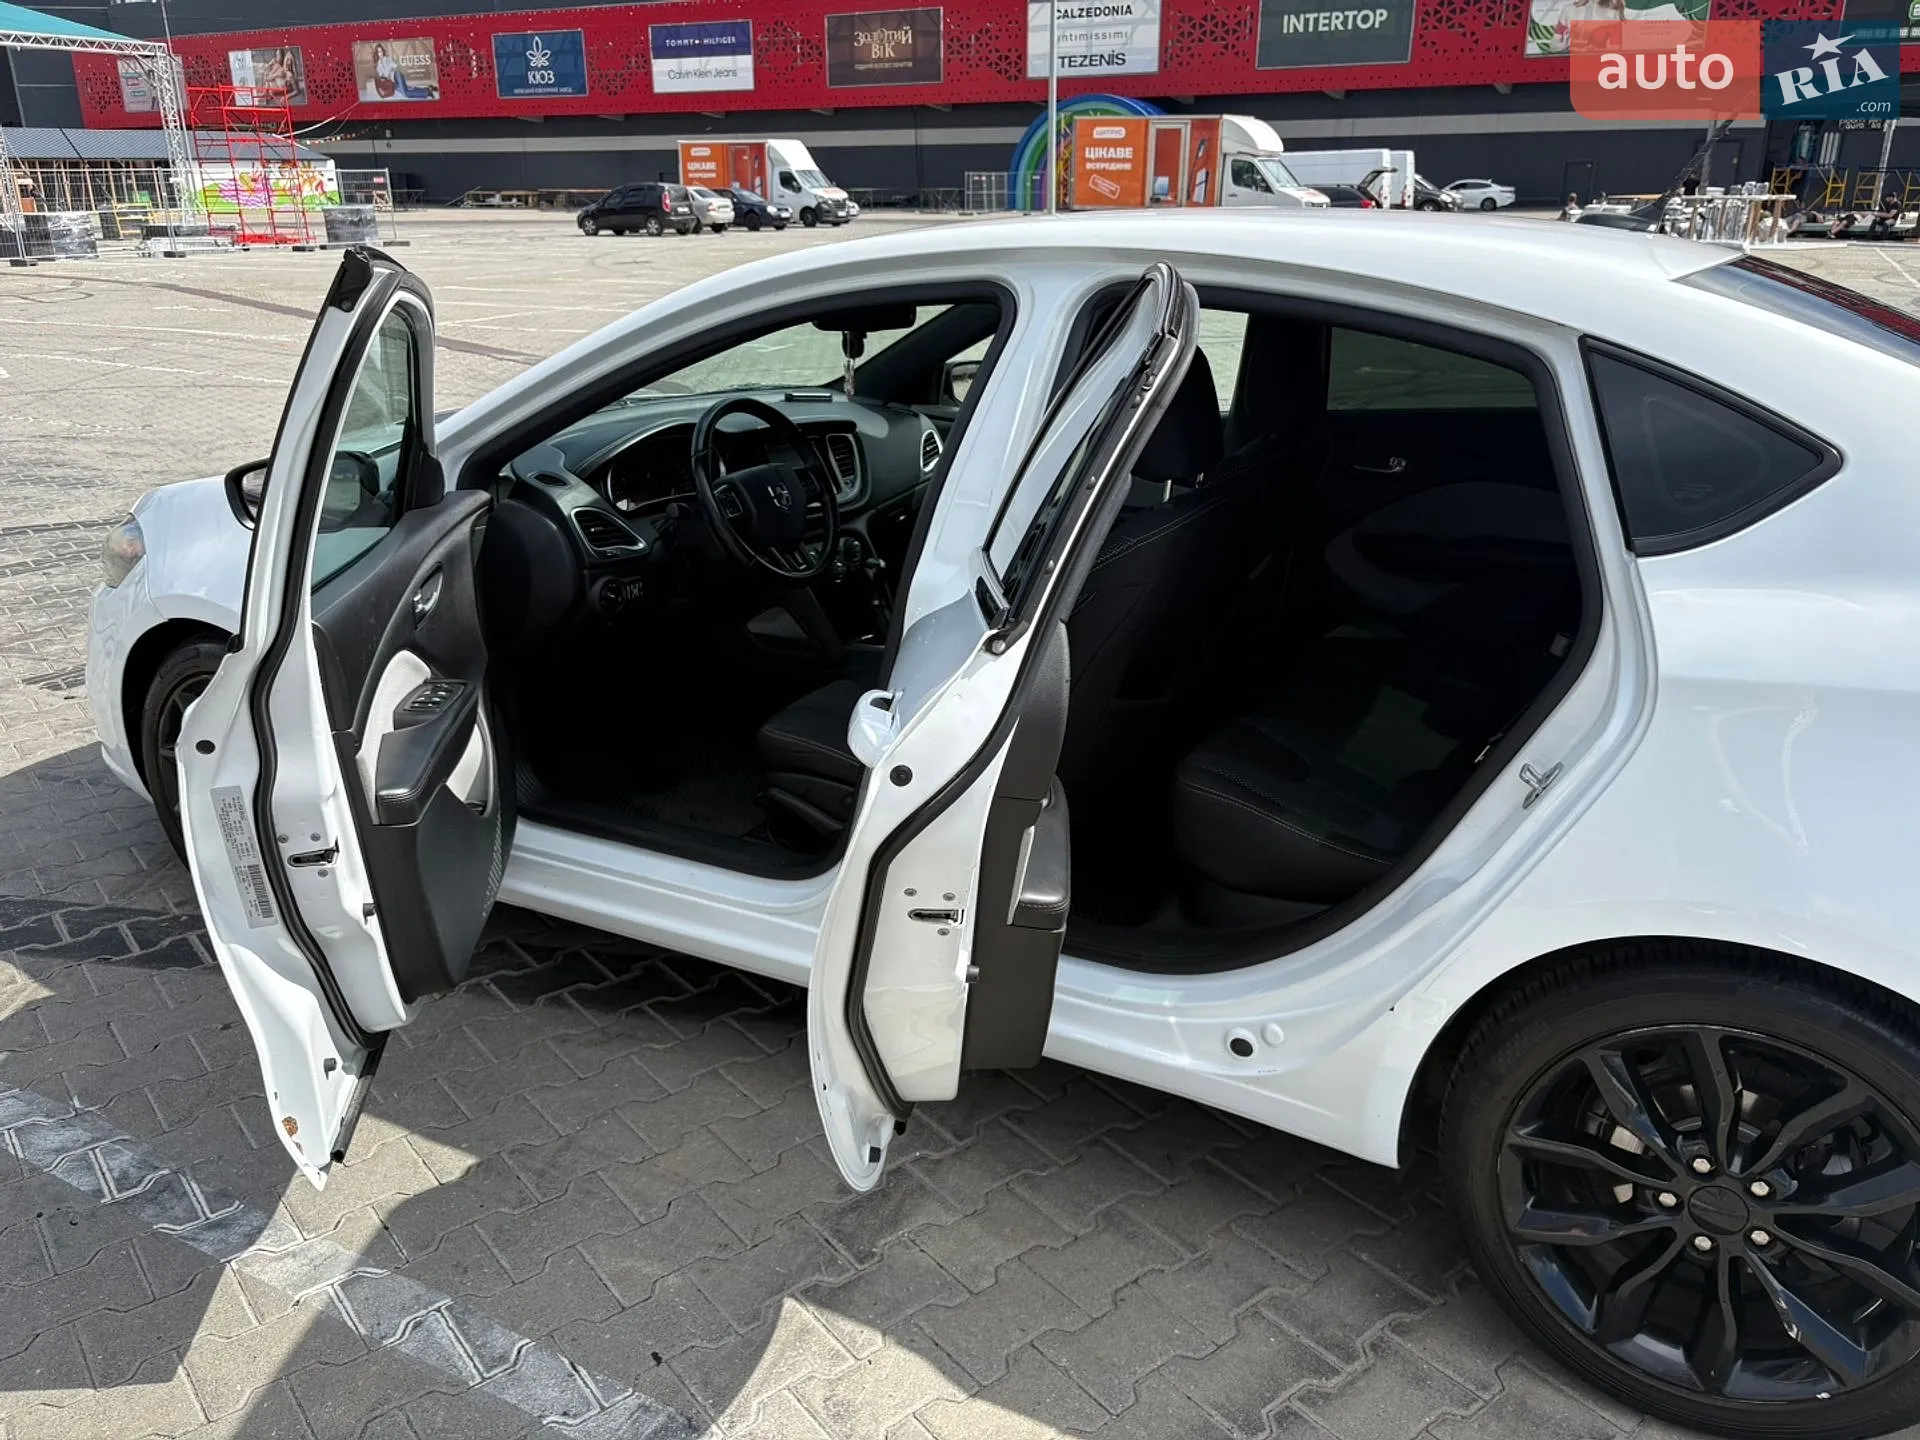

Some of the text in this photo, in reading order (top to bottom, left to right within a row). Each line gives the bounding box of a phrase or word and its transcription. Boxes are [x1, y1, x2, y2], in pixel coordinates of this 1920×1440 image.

[1283, 8, 1388, 34] INTERTOP
[665, 36, 736, 47] TOMMY HILFIGER
[399, 54, 431, 66] GUESS
[527, 70, 555, 84] КЮЗ
[667, 66, 738, 80] Calvin Klein Jeans
[1085, 146, 1133, 160] ЦІКАВЕ
